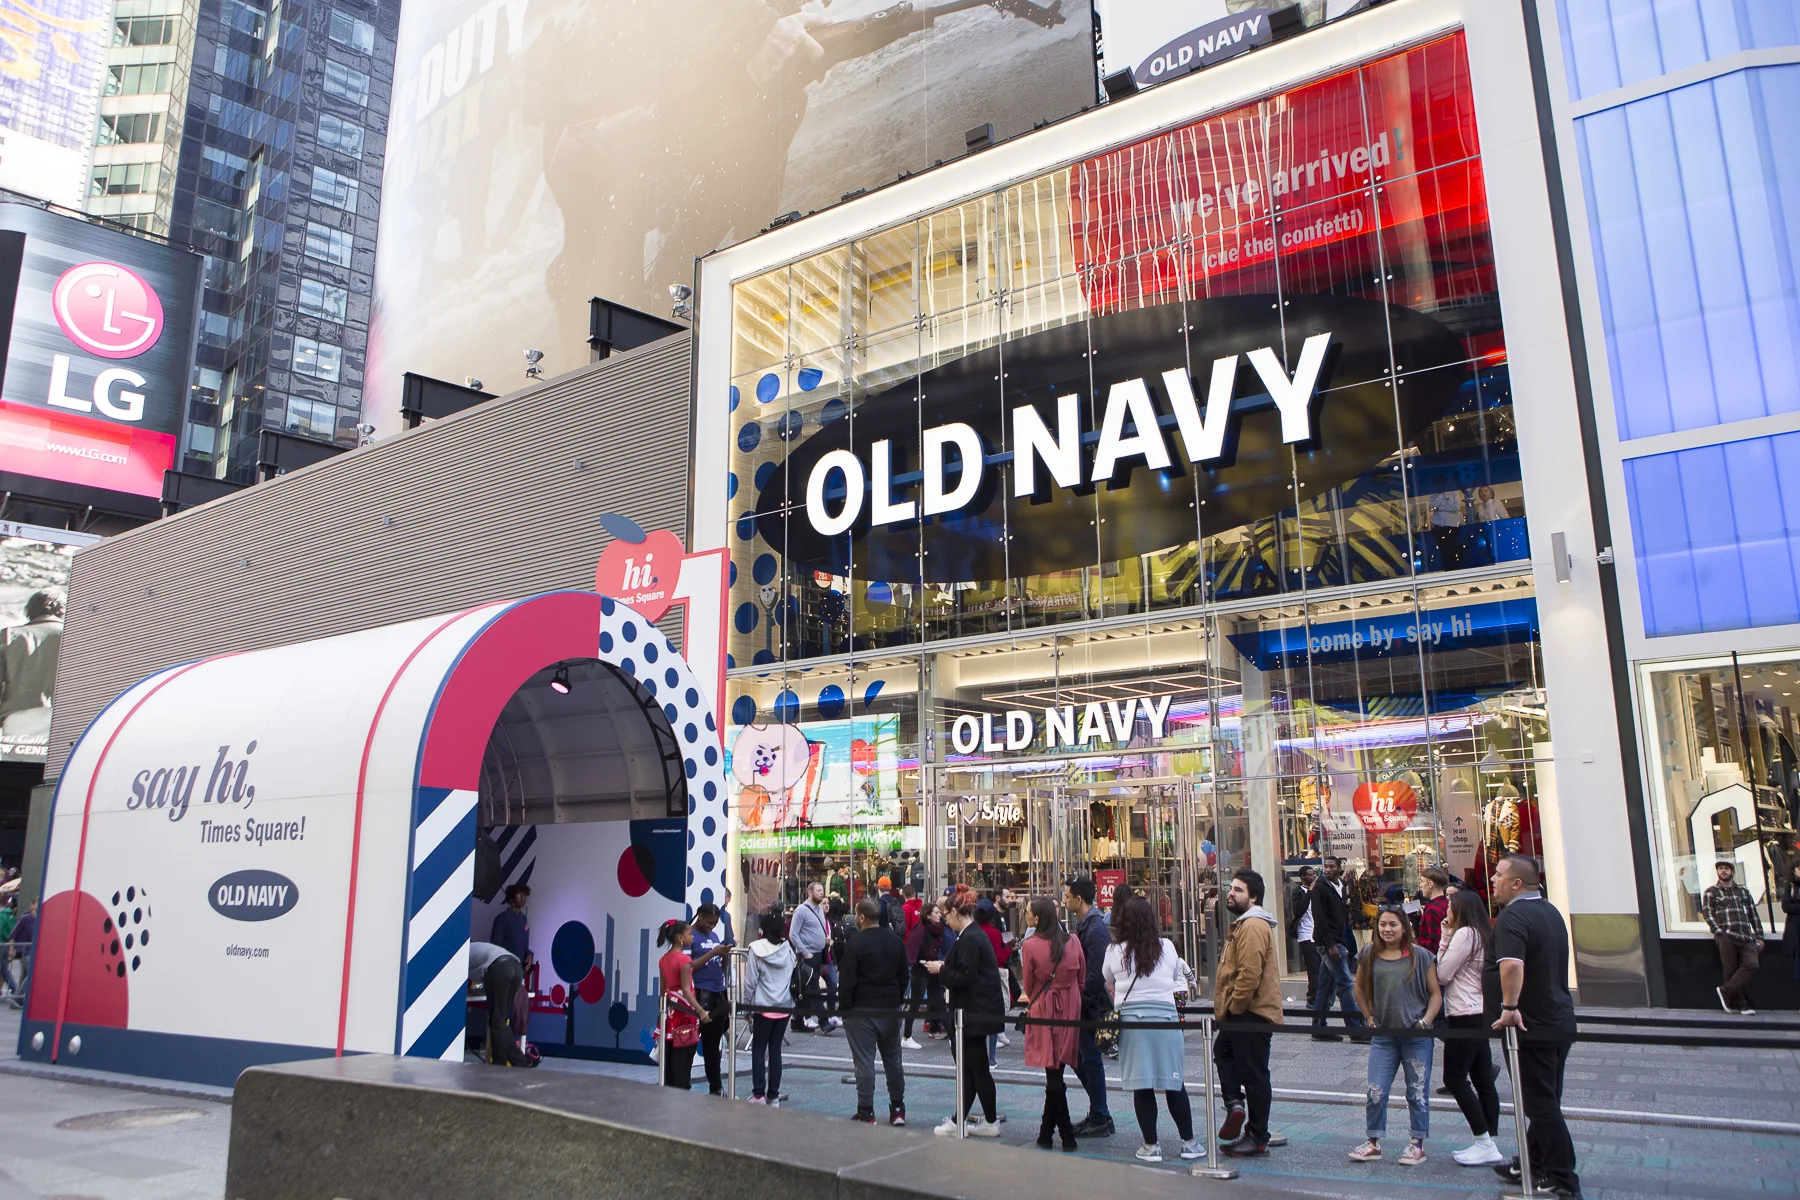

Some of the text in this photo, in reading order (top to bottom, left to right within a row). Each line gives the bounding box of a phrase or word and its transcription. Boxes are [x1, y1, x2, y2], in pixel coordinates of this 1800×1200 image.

[415, 0, 529, 124] DUTY
[1150, 44, 1194, 77] OLD
[1198, 14, 1263, 58] NAVY
[1244, 236, 1277, 258] the
[1281, 208, 1363, 247] confetti)
[47, 354, 147, 422] LG
[806, 332, 1333, 536] OLD NAVY
[46, 441, 128, 466] www.LG.com
[636, 591, 664, 604] Square
[1309, 630, 1363, 654] come
[1406, 621, 1442, 645] say
[1451, 613, 1473, 637] hi
[951, 694, 1173, 754] OLD NAVY
[127, 740, 257, 822] say hi,
[1382, 771, 1394, 780] OLD
[982, 800, 1021, 825] Style
[1384, 815, 1408, 823] Square
[201, 816, 306, 846] Times Square!
[217, 885, 288, 907] OLD NAVY
[226, 944, 269, 960] oldnavy.com
